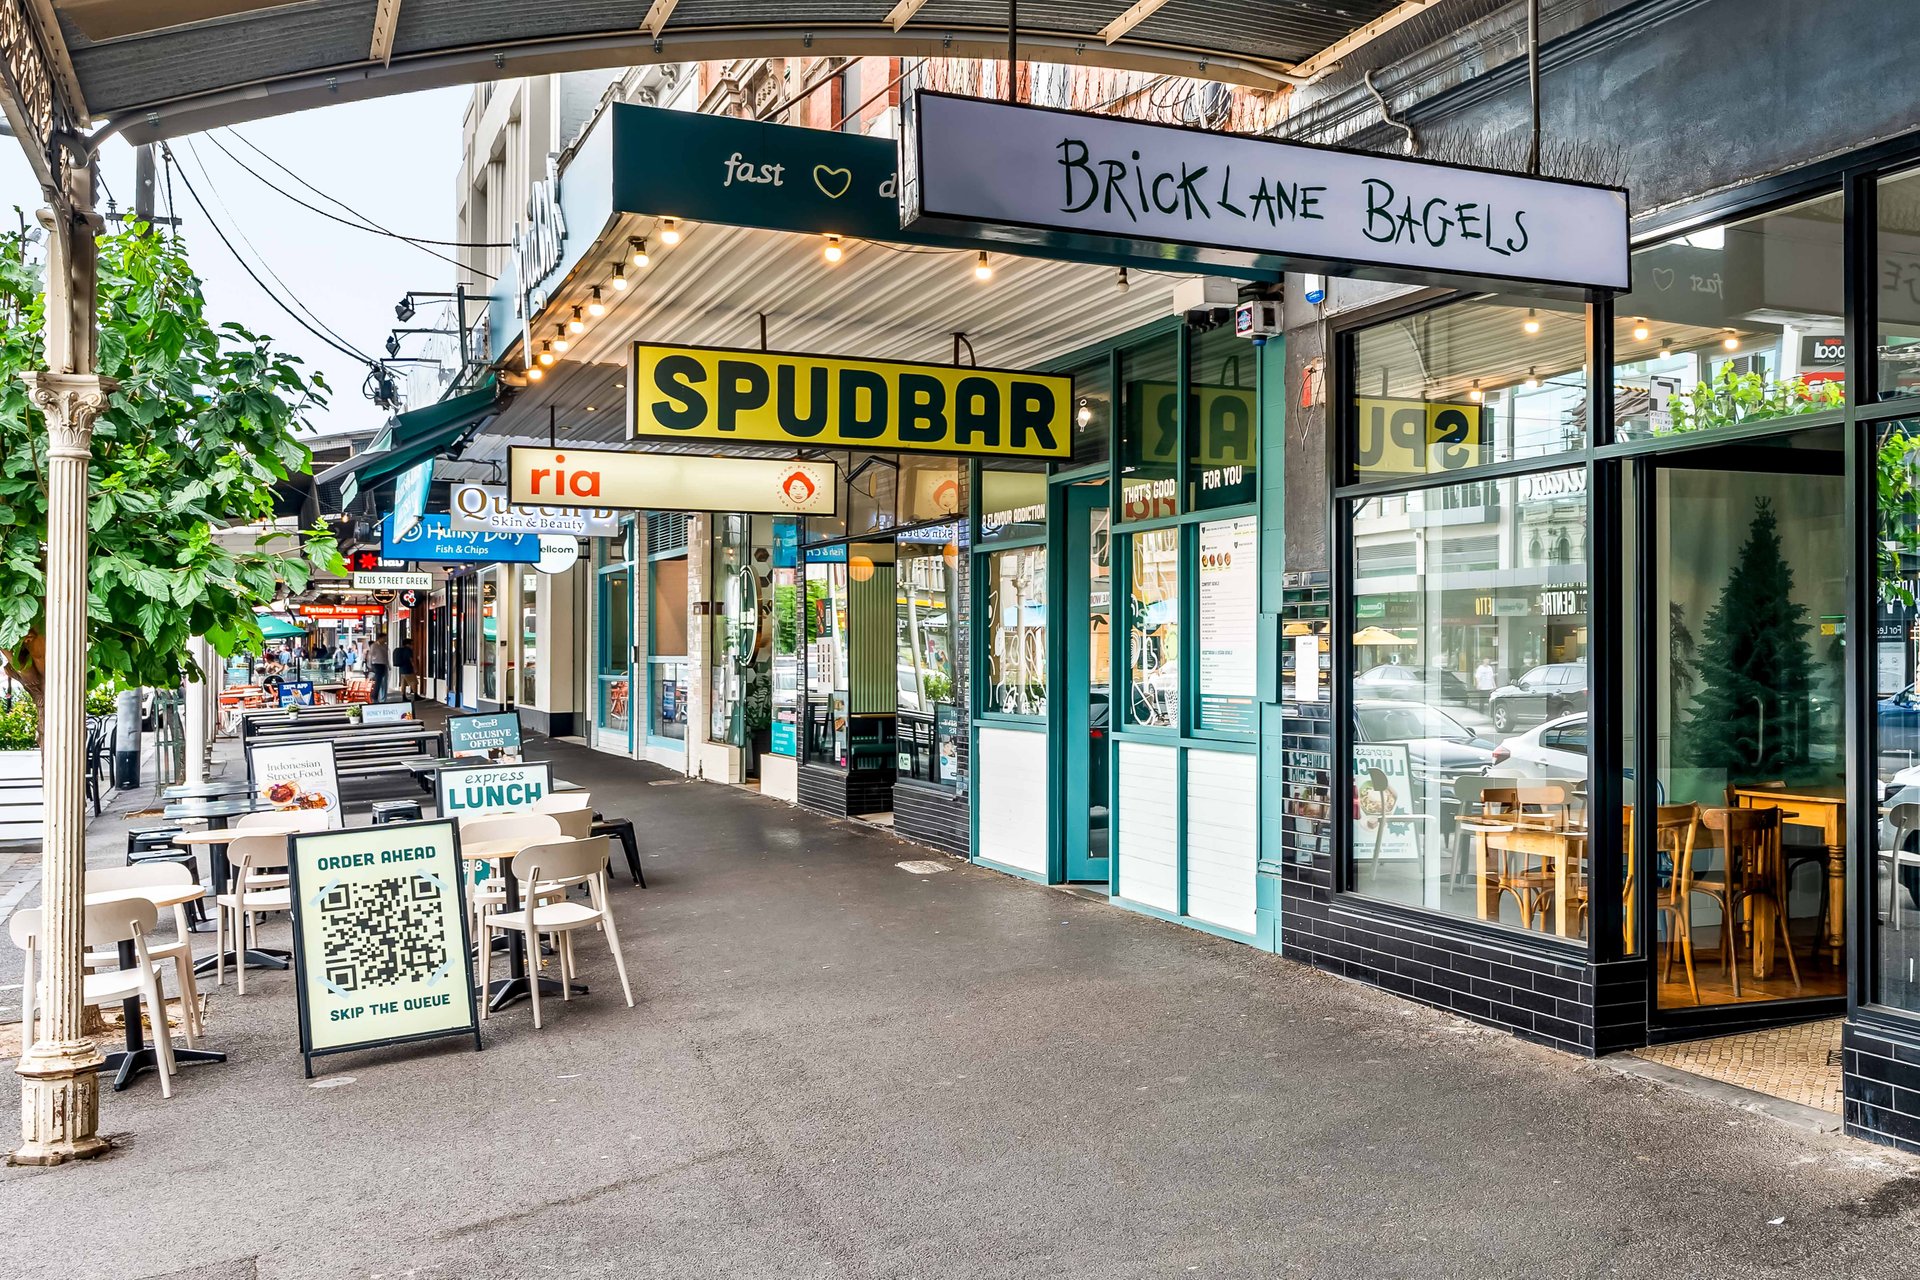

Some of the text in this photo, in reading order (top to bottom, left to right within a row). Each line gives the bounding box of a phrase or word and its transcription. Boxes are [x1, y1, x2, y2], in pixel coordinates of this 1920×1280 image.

[724, 152, 785, 187] fast
[1217, 165, 1327, 227] LANE
[1362, 178, 1528, 256] BAGELS
[651, 355, 1058, 449] SPUDBAR
[530, 454, 601, 497] ria
[1203, 465, 1243, 490] FOR YOU
[1124, 479, 1176, 504] THAT'S GOOD
[491, 516, 585, 532] Skin & Beauty
[987, 510, 1013, 526] FLAVOUR
[1013, 504, 1046, 522] ADDICTION
[436, 545, 489, 556] Fish & Chips
[358, 576, 429, 585] ZEUS STREET GREEK
[335, 606, 358, 614] Pizza
[460, 729, 512, 741] EXCLUSIVE
[469, 738, 505, 748] OFFERS
[266, 769, 324, 781] Street Food
[267, 760, 321, 772] Indonesian
[465, 771, 524, 786] express
[449, 782, 542, 809] LUNCH
[317, 846, 436, 871] ORDER AHEAD
[330, 994, 451, 1022] SKIP THE QUEUE
